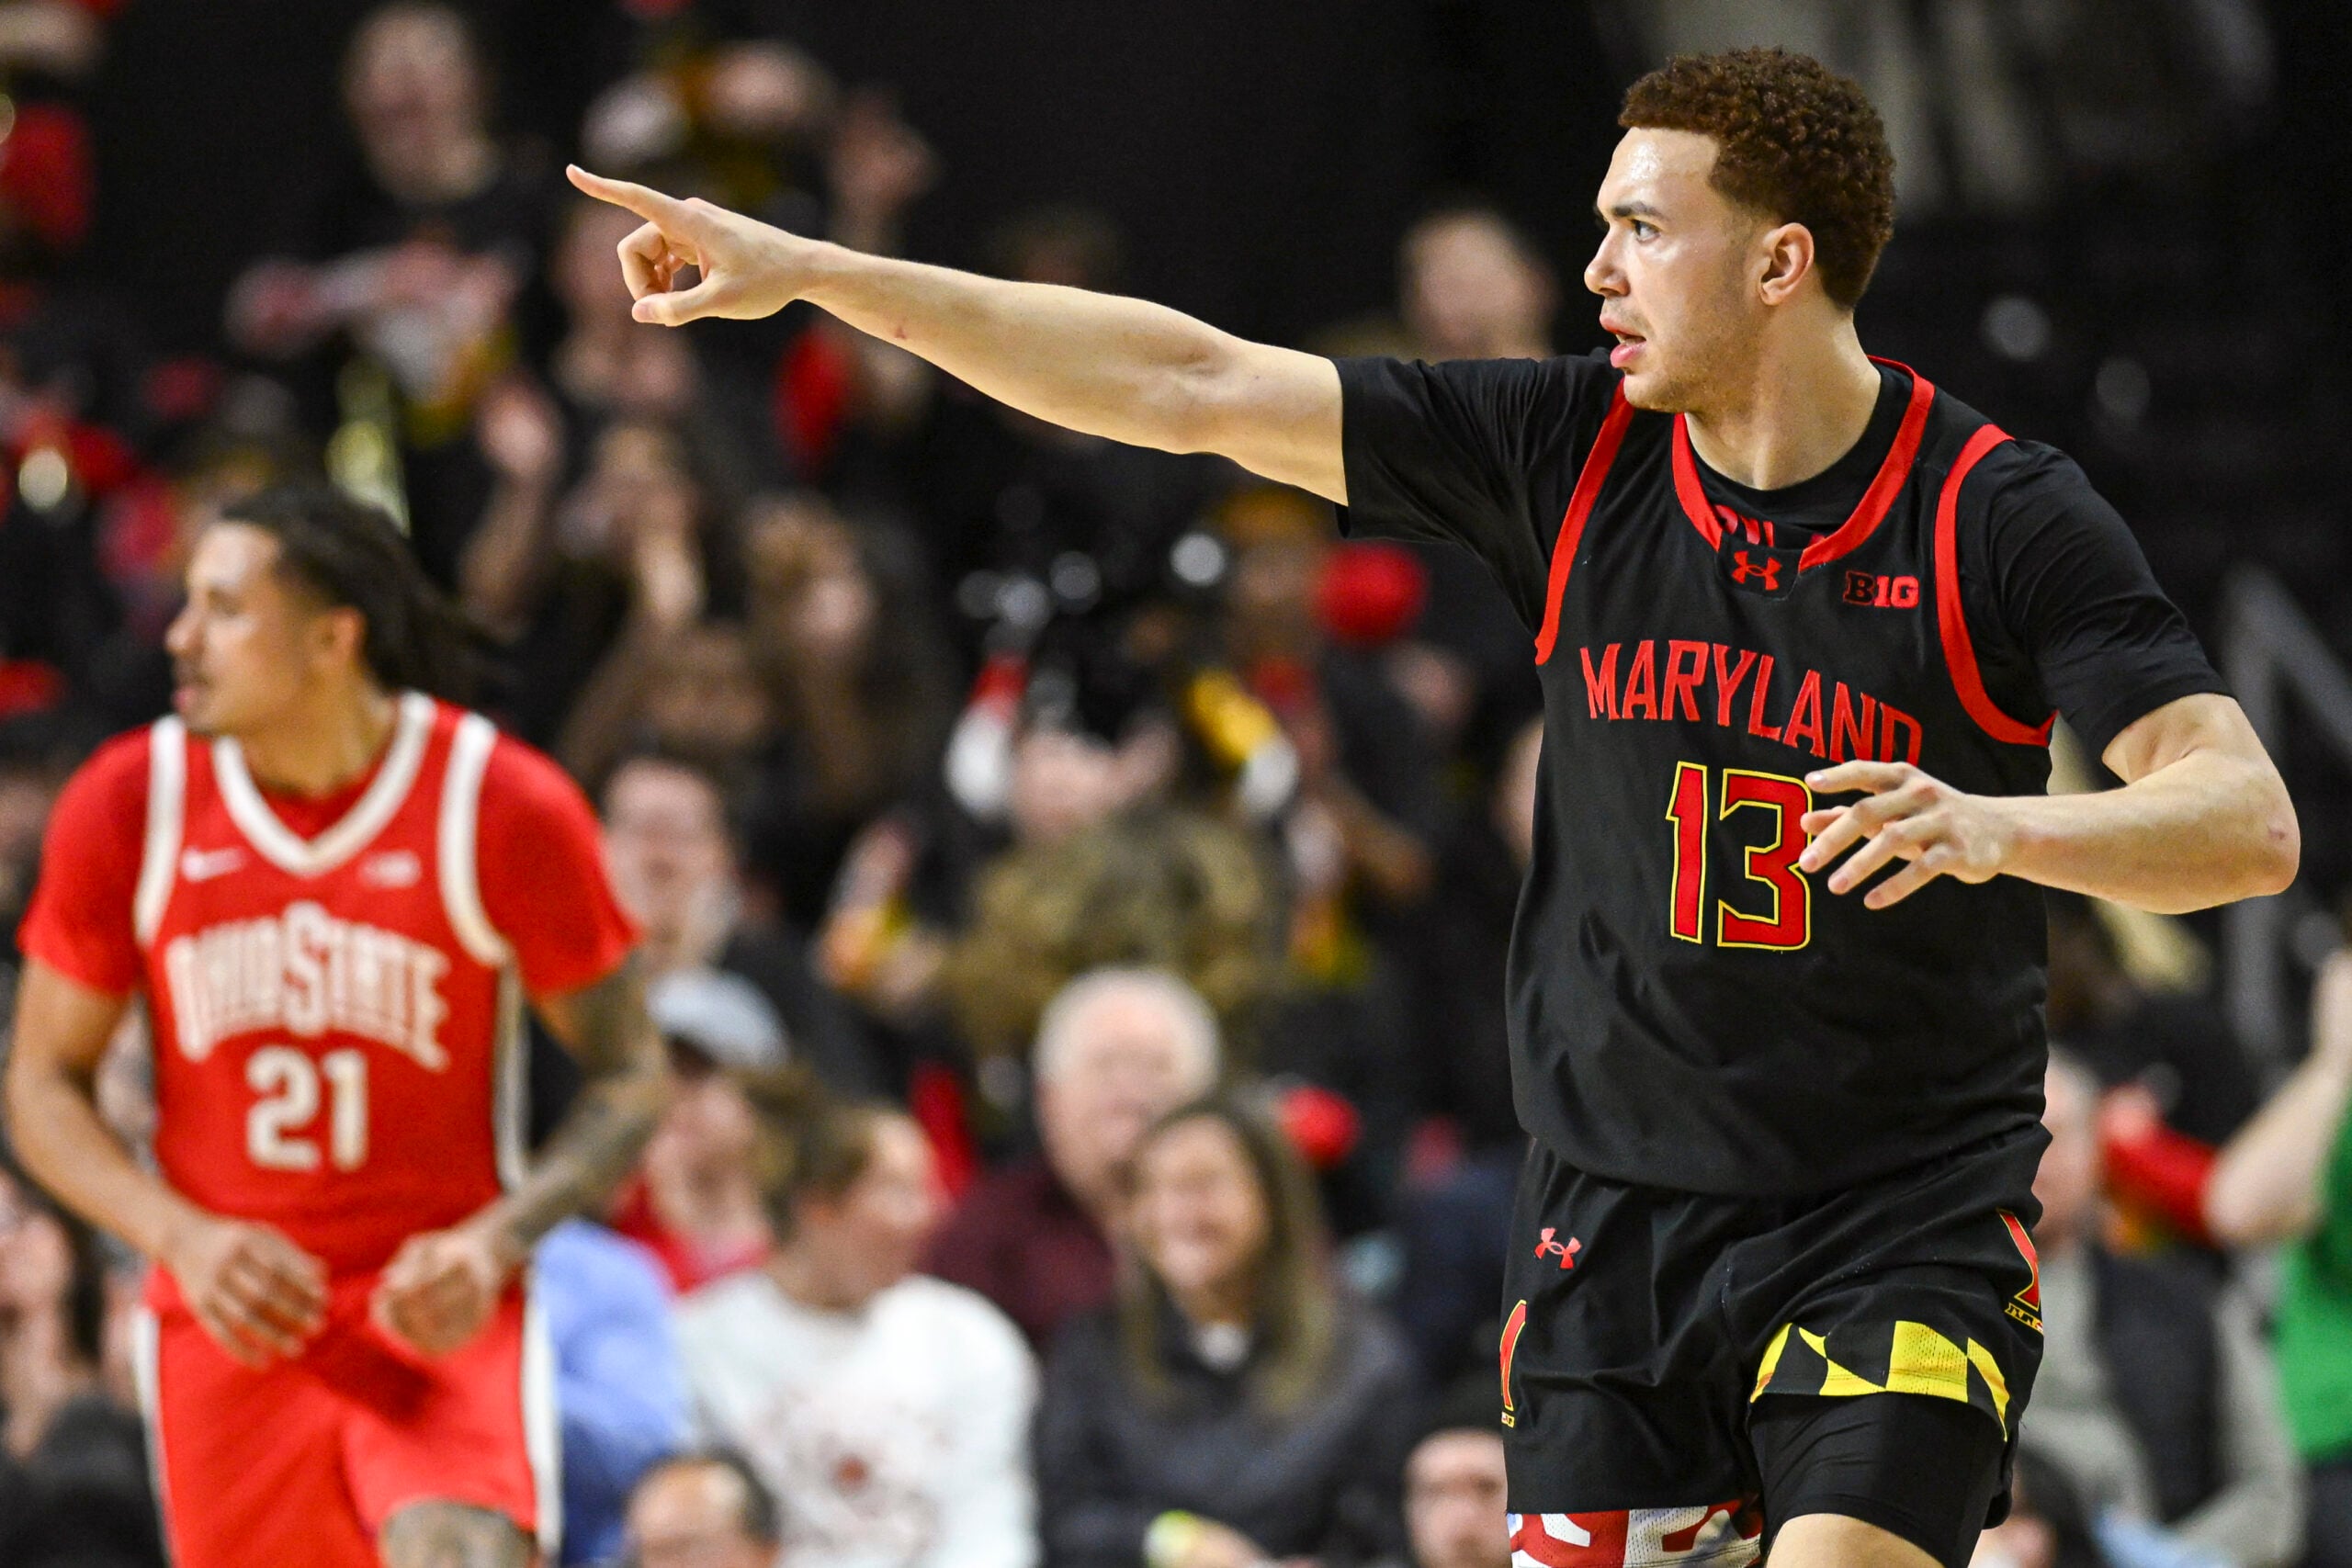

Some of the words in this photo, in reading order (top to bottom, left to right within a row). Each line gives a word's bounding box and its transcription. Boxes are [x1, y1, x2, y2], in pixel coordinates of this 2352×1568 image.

[1579, 640, 1923, 768] MARYLAND
[1665, 761, 1814, 952] 13
[245, 1045, 369, 1172] 21
